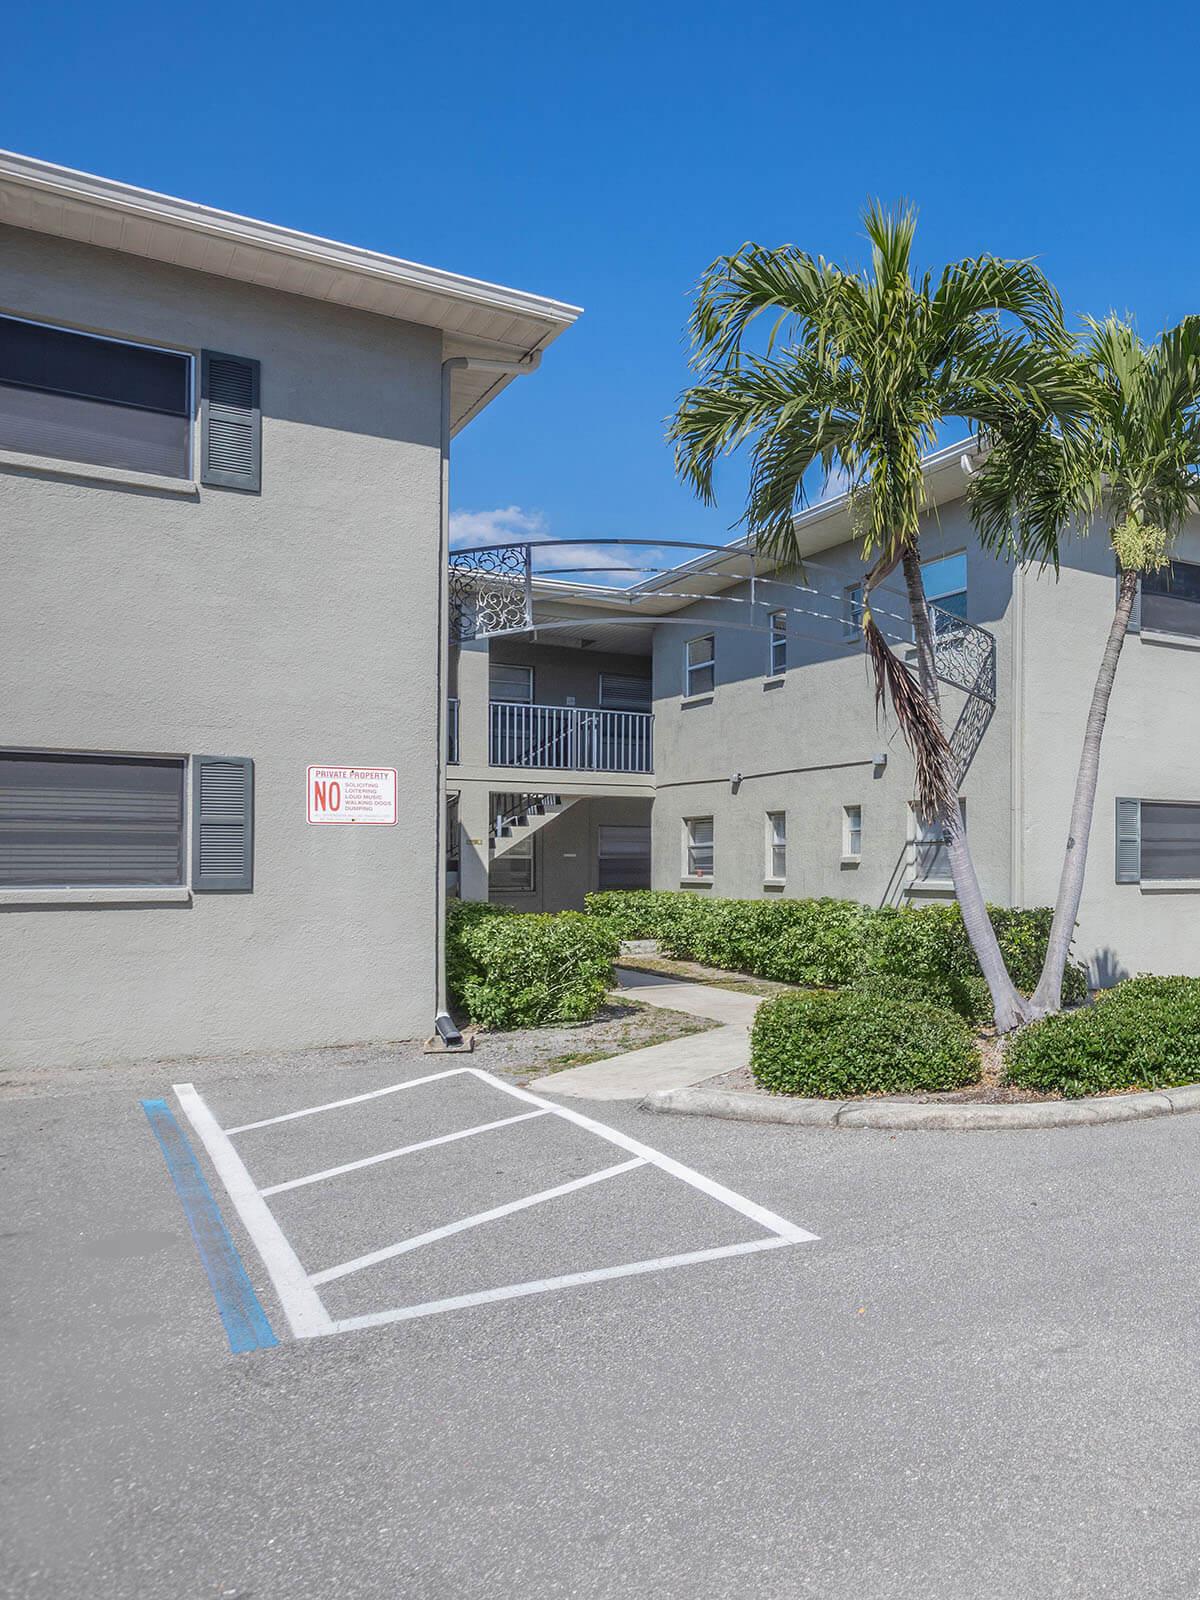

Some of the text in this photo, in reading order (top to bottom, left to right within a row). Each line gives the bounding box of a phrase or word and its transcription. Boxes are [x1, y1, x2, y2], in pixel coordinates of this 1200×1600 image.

[315, 770, 389, 780] PRIVATE PROPERTY
[314, 781, 340, 812] NO
